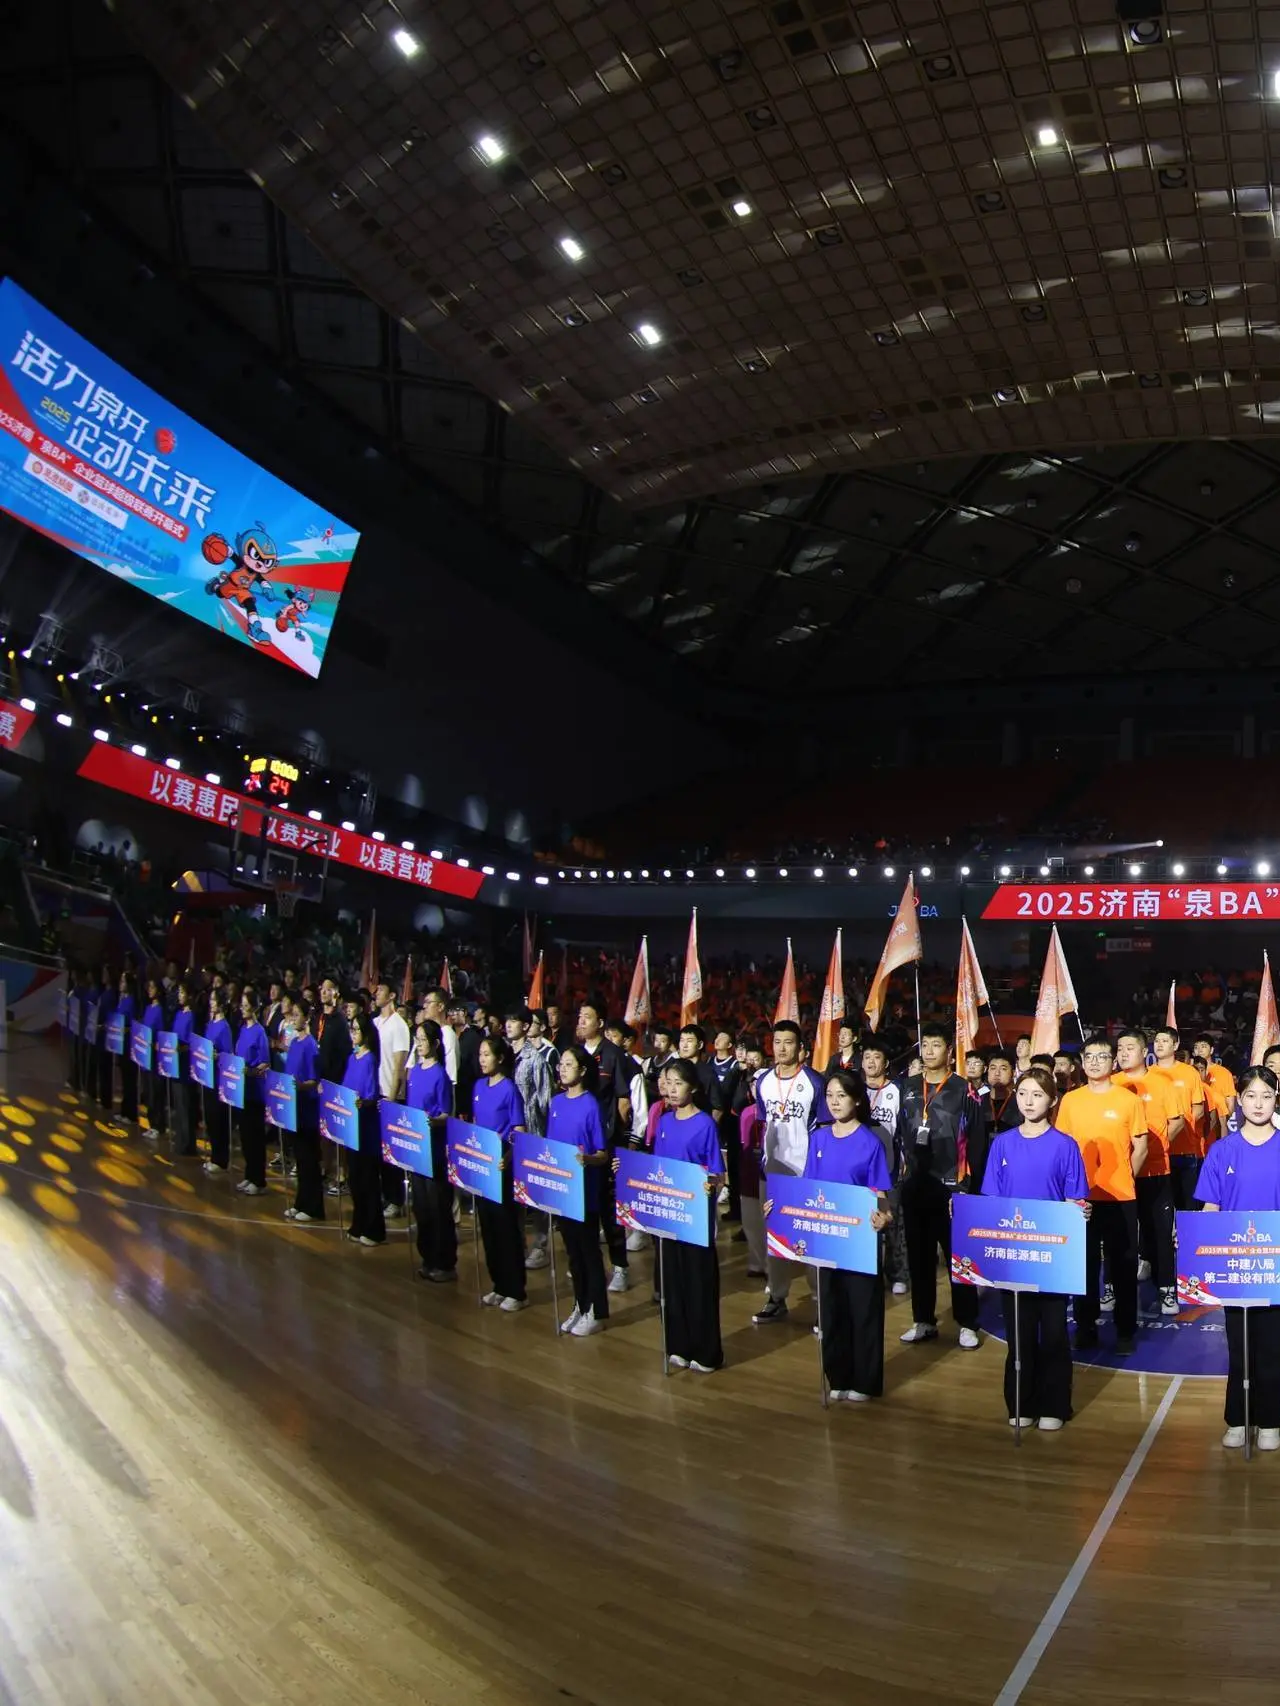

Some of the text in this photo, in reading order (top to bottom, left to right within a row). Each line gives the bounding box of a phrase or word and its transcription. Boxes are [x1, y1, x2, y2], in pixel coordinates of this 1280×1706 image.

[11, 330, 150, 444] 活力泉开
[40, 396, 72, 424] 2025
[65, 415, 218, 529] 企动未来
[269, 775, 290, 796] 24
[149, 770, 240, 827] 以赛惠民
[359, 841, 433, 885] 以赛营城
[984, 1246, 1052, 1264] 济南能源集团
[1227, 1258, 1275, 1270] 中建八局
